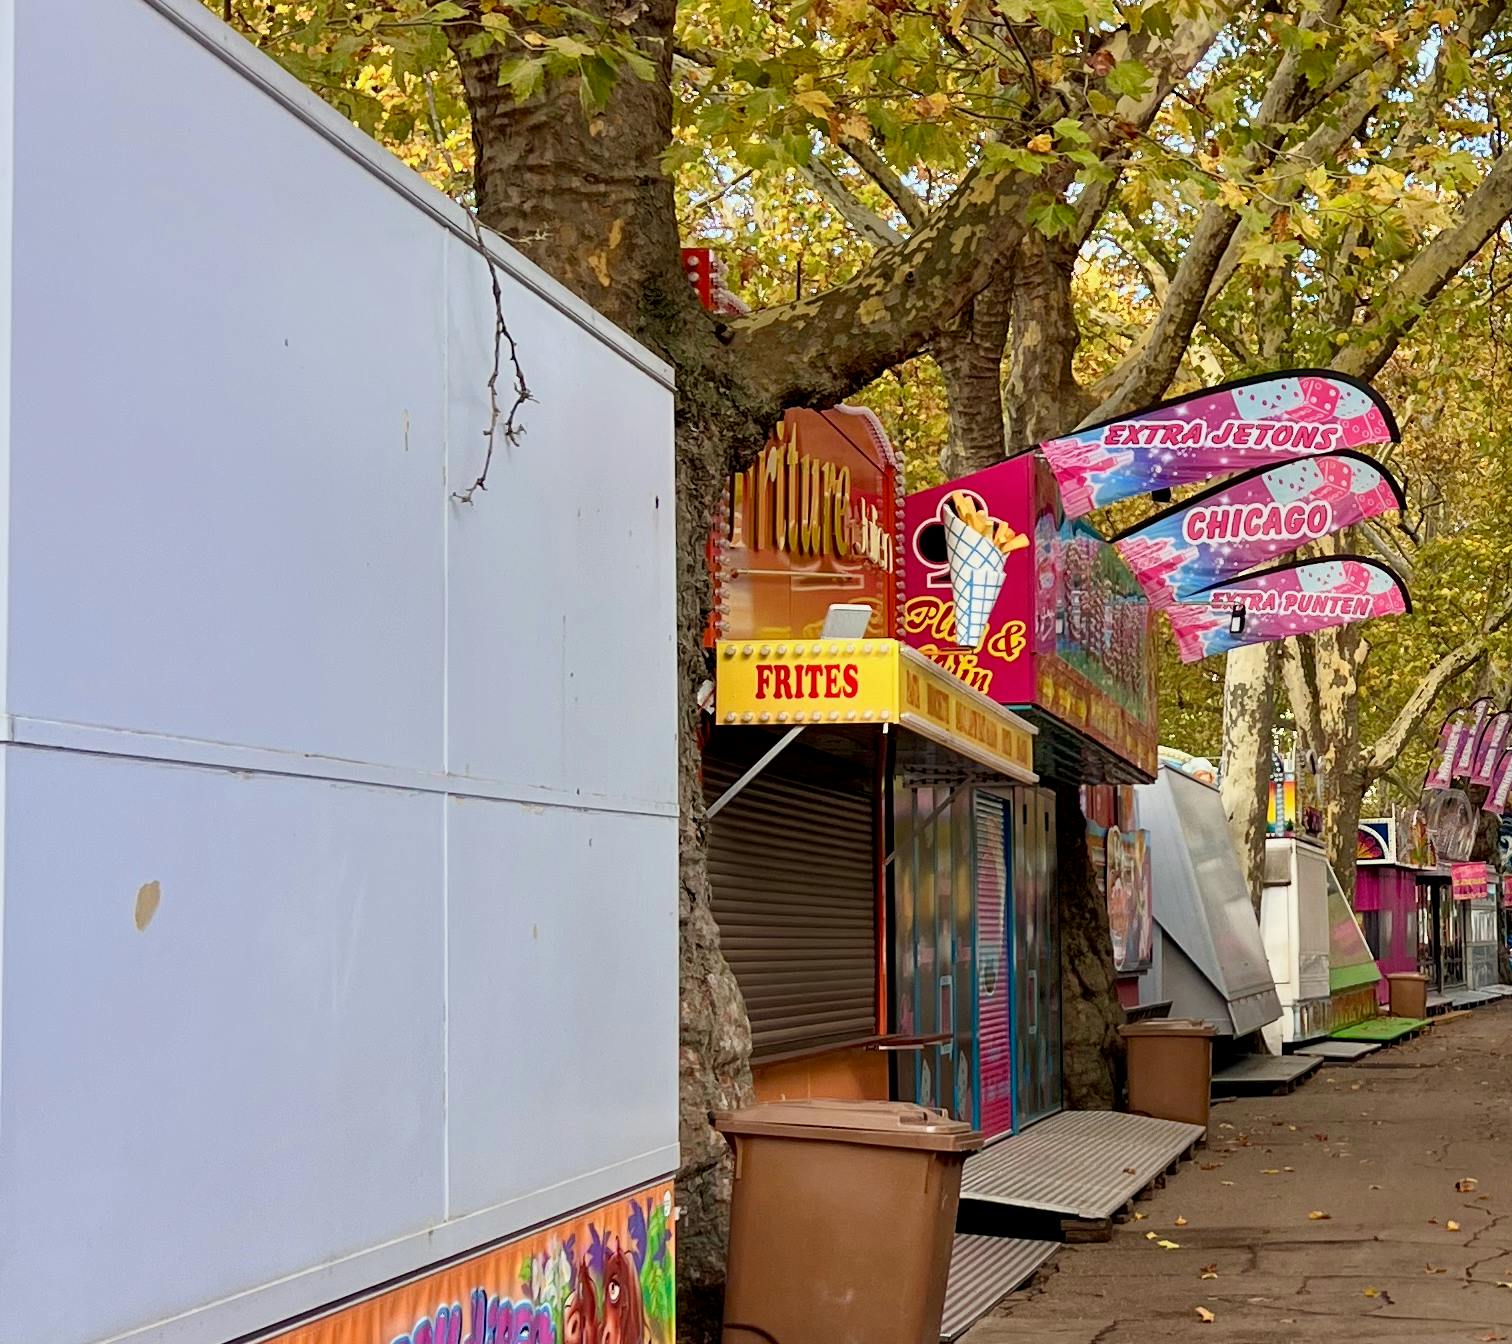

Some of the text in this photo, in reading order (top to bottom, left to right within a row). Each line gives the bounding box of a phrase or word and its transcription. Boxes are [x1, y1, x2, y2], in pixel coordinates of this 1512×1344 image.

[1102, 421, 1341, 450] EXTRA JETONS
[1185, 504, 1330, 541] CHICAGO
[1210, 590, 1372, 617] EXTRA PUNTEN
[755, 664, 859, 700] FRITES
